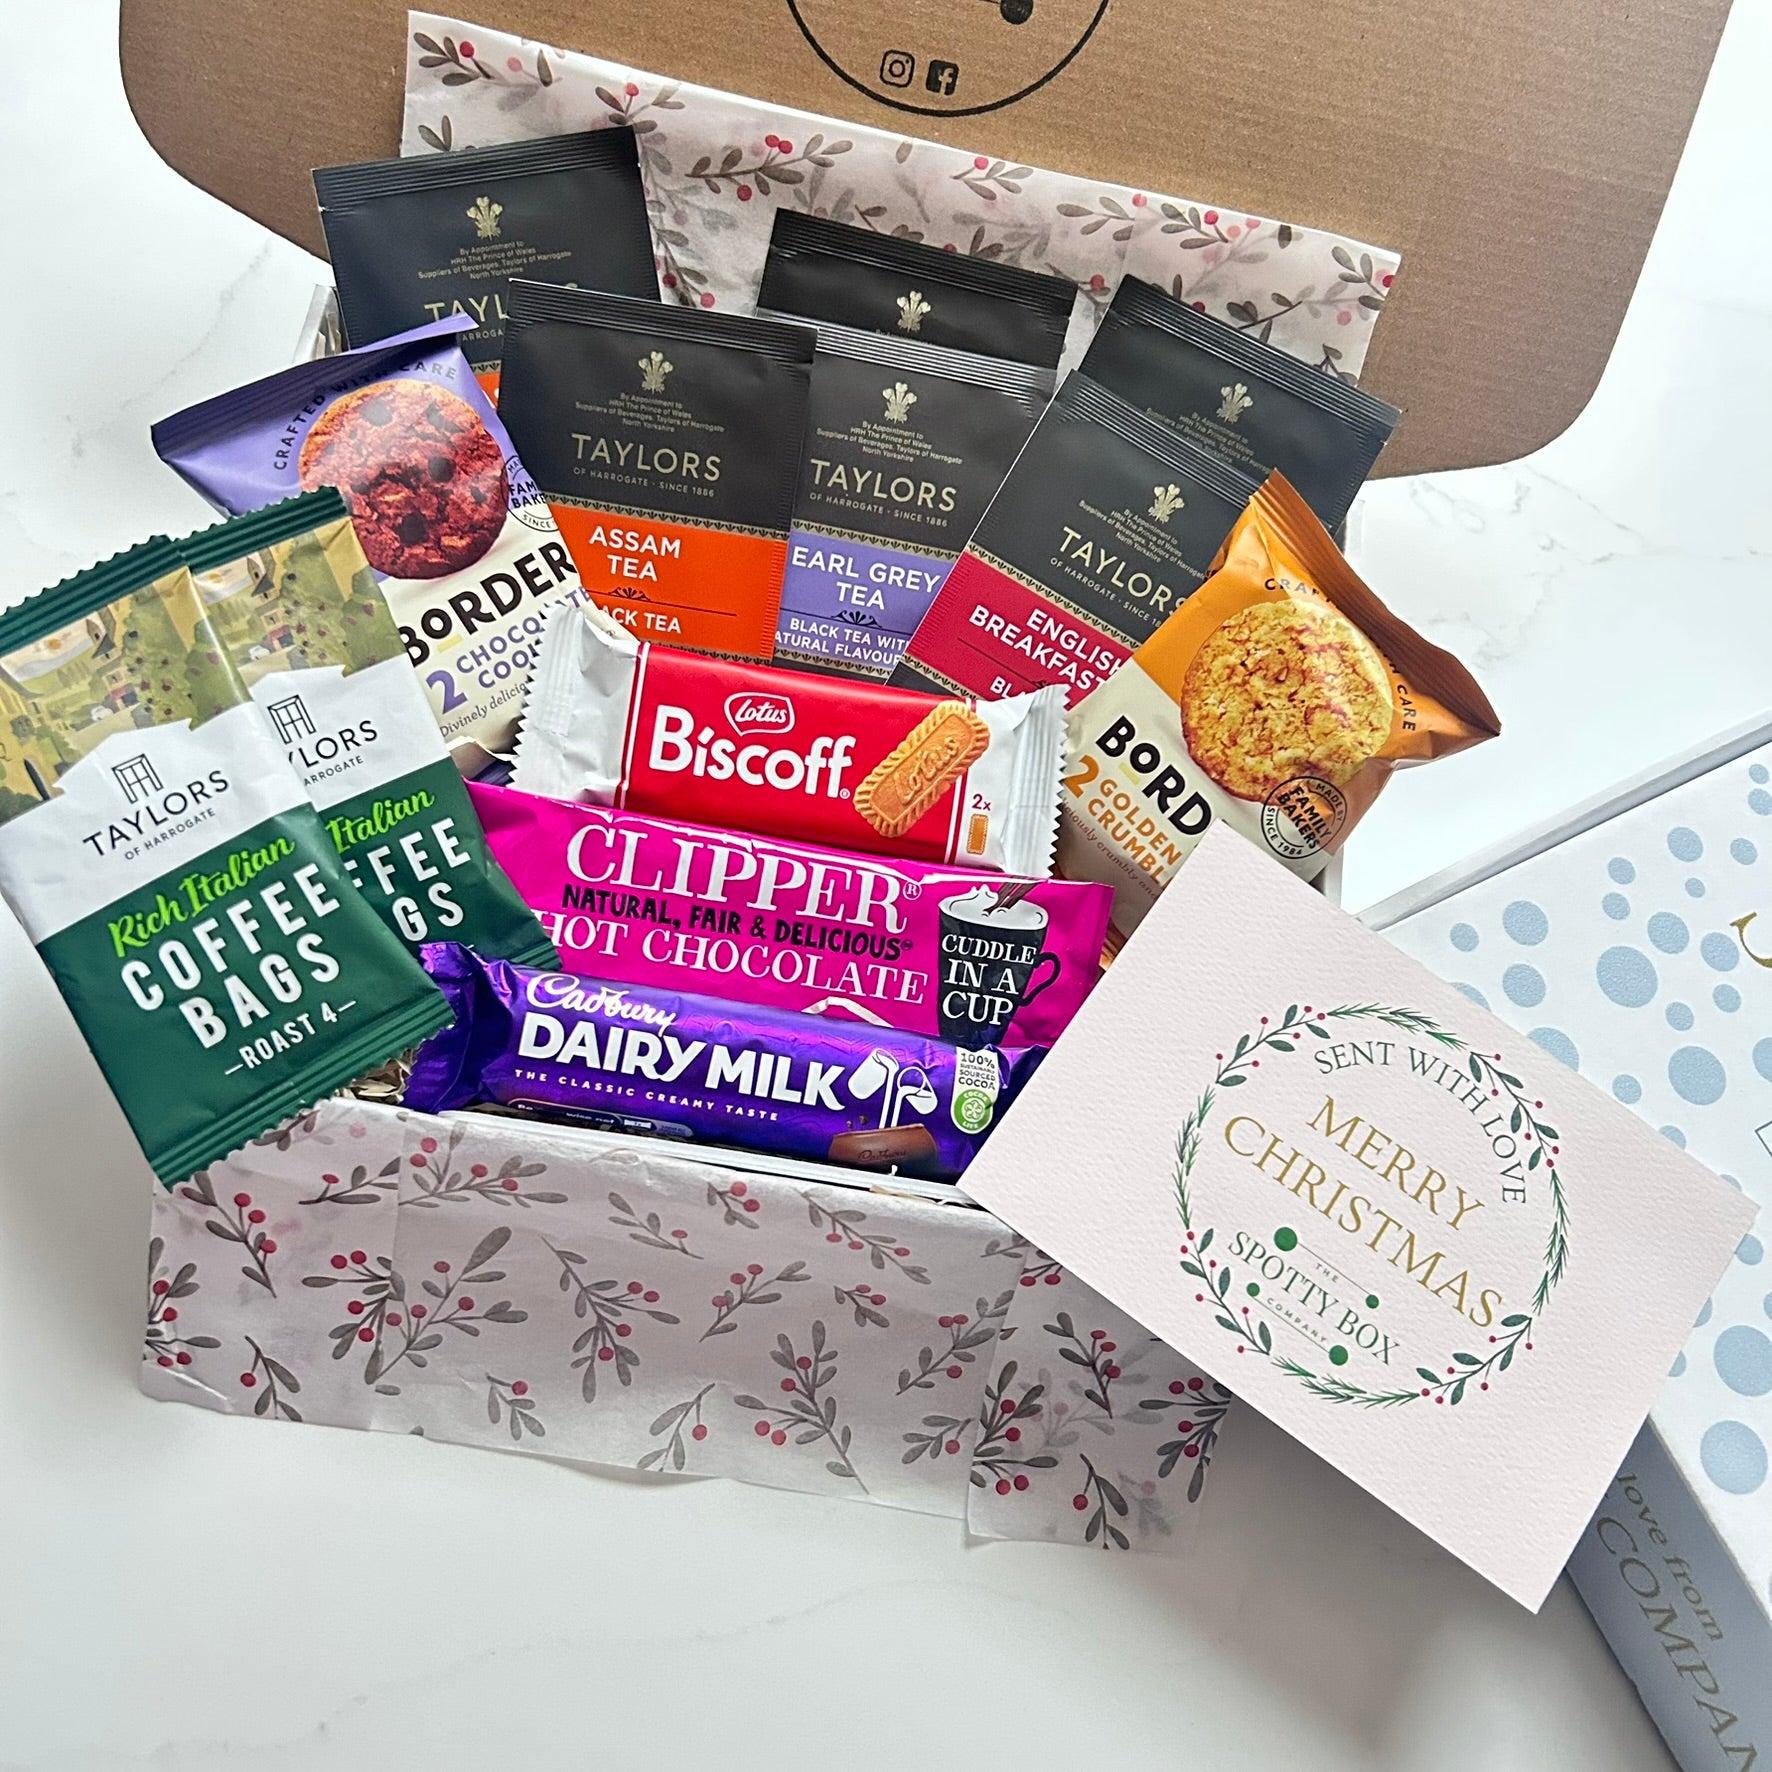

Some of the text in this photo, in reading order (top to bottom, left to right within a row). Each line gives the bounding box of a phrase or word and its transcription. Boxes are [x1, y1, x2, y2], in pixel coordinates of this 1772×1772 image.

[424, 294, 508, 322] TAYL
[462, 329, 504, 342] ARROGA
[274, 394, 326, 470] CRAFTED
[571, 432, 721, 482] TAYLORS
[508, 481, 537, 496] FAM
[573, 467, 715, 498] OF HARROGATE SINCE 1886
[810, 458, 957, 512] TAYLORS
[523, 514, 551, 529] SINCE
[810, 492, 948, 528] OF HARROGATE SINCE 1886
[1126, 519, 1137, 530] The
[1137, 526, 1156, 541] Prince
[589, 525, 681, 559] ASSAM
[1115, 531, 1133, 546] North
[1149, 541, 1171, 559] Taylors
[1176, 559, 1204, 580] Harrogat
[607, 554, 658, 582] TEA
[791, 545, 941, 593] EARL GREY
[1050, 557, 1150, 621] OF HARROGATE SINCE
[398, 541, 577, 668] BORDER
[602, 605, 681, 634] ACK TEA
[836, 582, 885, 610] TEA
[775, 631, 830, 653] ATURAL
[790, 618, 838, 639] BLACK
[844, 629, 871, 645] TEA
[425, 669, 468, 715] 2
[439, 682, 528, 738] Divinely delicio
[735, 699, 787, 724] Lotus
[1397, 685, 1416, 731] CARE
[289, 720, 378, 768] LORS
[303, 755, 364, 787] ARROGATE
[1095, 715, 1212, 835] BORD
[82, 770, 229, 857] TAYLORS
[325, 791, 435, 854] Italian
[972, 794, 991, 811] 2x
[1063, 755, 1182, 866] 2 GOLDEN
[1277, 793, 1320, 849] BAKERS
[1289, 786, 1331, 839] FAMILY
[124, 808, 216, 860] OF HARROGATE
[1088, 798, 1165, 885] CRUMBL
[1266, 807, 1302, 855] SINCE 1984
[344, 817, 471, 896] FEE
[1097, 841, 1138, 880] crumbly
[108, 837, 296, 958] Rich Italian
[392, 882, 464, 942] GS
[121, 863, 341, 1011] COFFEE
[562, 884, 903, 961] NATURAL, FAIR & DELICIOUS
[530, 908, 928, 1005] HOT CHOCOLATE
[942, 933, 1037, 965] CUDDLE
[179, 933, 340, 1049] BAGS
[944, 958, 1019, 995] IN A
[527, 973, 677, 1037] Cadbury
[942, 990, 1014, 1026] CUP
[239, 1002, 338, 1069] ROAST 4
[518, 1011, 846, 1111] DAIRY MILK
[958, 1076, 996, 1090] COCOA
[959, 1069, 996, 1082] SOURCED
[961, 1053, 995, 1069] 100%
[514, 1069, 779, 1122] THE CLASSIC CREAMY TASTE
[1314, 1041, 1526, 1204] SENT WITH LOVE
[1306, 1095, 1485, 1231] MERRY
[1224, 1115, 1503, 1328] CHRISTMAS
[1315, 1263, 1338, 1283] THE
[1228, 1231, 1400, 1366] SPOTTY BOX
[1267, 1298, 1328, 1343] COMPANY
[1615, 1471, 1724, 1641] love from
[1596, 1516, 1759, 1772] COMPAN
